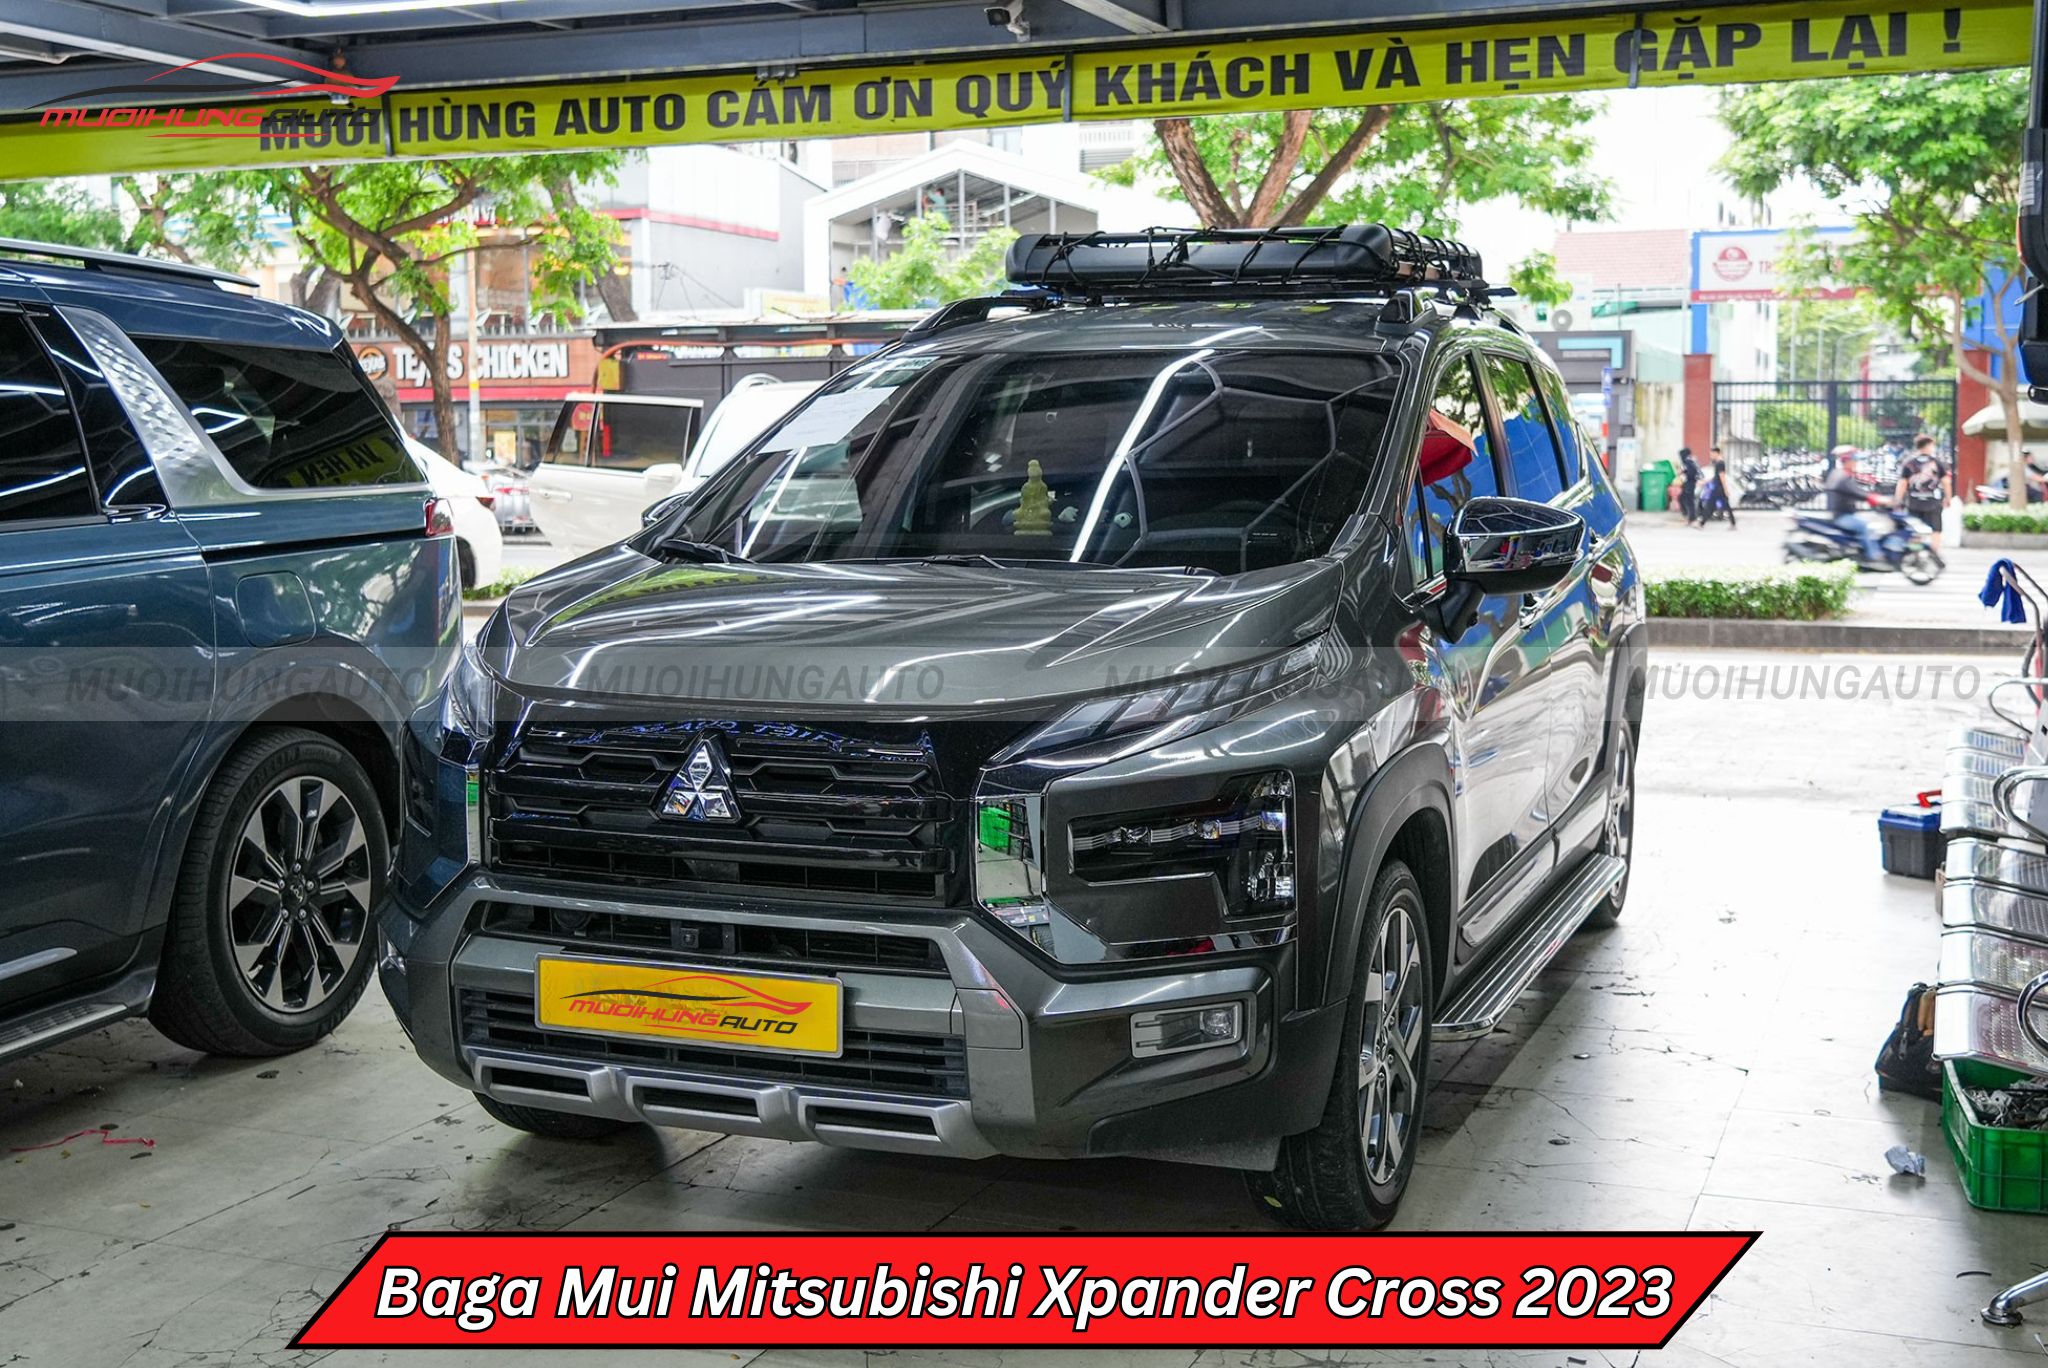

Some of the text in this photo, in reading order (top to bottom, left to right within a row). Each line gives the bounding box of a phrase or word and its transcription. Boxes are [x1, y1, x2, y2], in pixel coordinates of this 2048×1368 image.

[400, 97, 536, 143] HÙNG
[554, 93, 686, 136] AUTO
[854, 77, 933, 120] ƠN
[956, 60, 1064, 118] QUÝ
[1094, 51, 1310, 107] KHÁCH
[1334, 37, 1421, 91] VÀ
[1446, 33, 1585, 90] HẸN
[1614, 16, 1762, 80] GẶP
[1792, 11, 1907, 70] LẠI
[392, 345, 464, 388] TEXS
